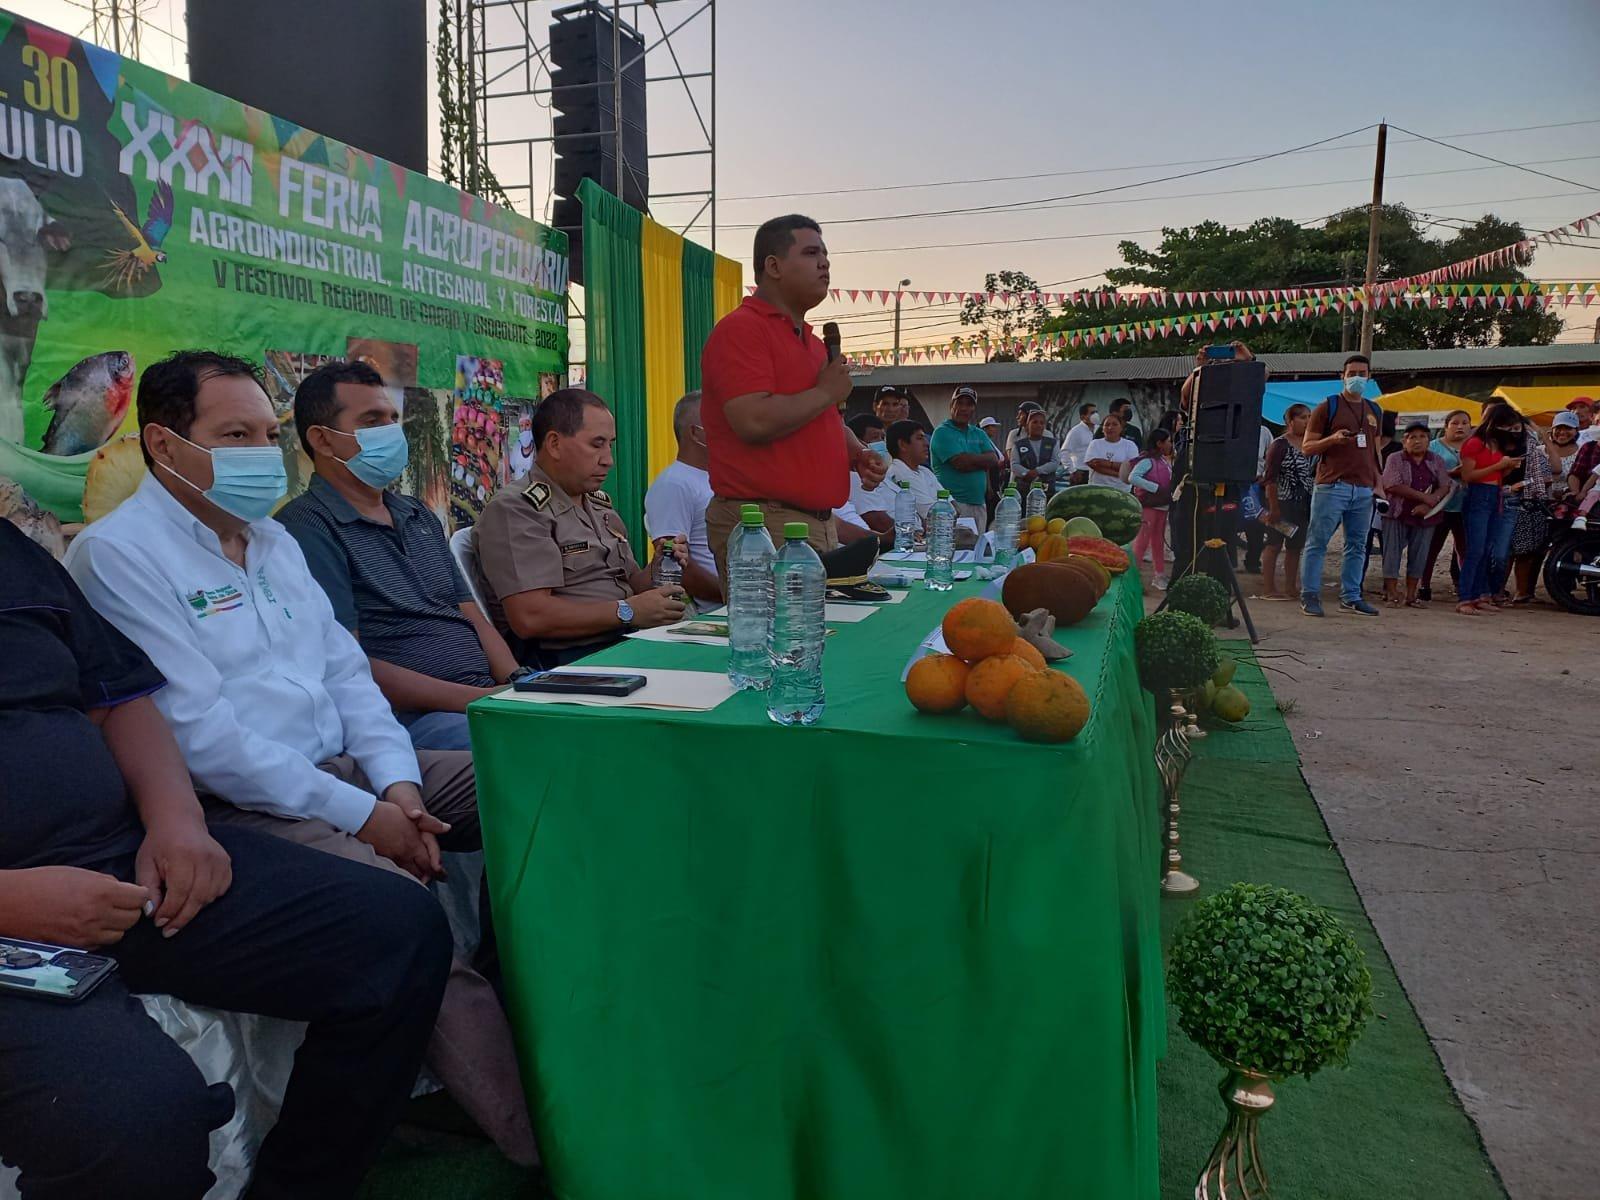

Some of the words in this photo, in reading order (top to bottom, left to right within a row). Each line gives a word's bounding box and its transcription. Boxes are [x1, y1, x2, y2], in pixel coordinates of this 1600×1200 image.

[22, 45, 79, 120] 30
[0, 102, 83, 178] ULIO
[190, 206, 391, 287] AGROINDUSTRIAL,
[402, 261, 491, 309] ARTESANAL
[496, 286, 507, 312] Y
[512, 291, 567, 328] FORESTAL
[279, 155, 382, 243] FERIA
[402, 200, 569, 297] AGROPECUARIA
[213, 259, 227, 289] V
[234, 263, 317, 304] FESTIVAL
[321, 281, 396, 319] REGIONAL
[400, 298, 416, 322] DE
[463, 311, 470, 332] Y
[535, 328, 557, 351] 2022
